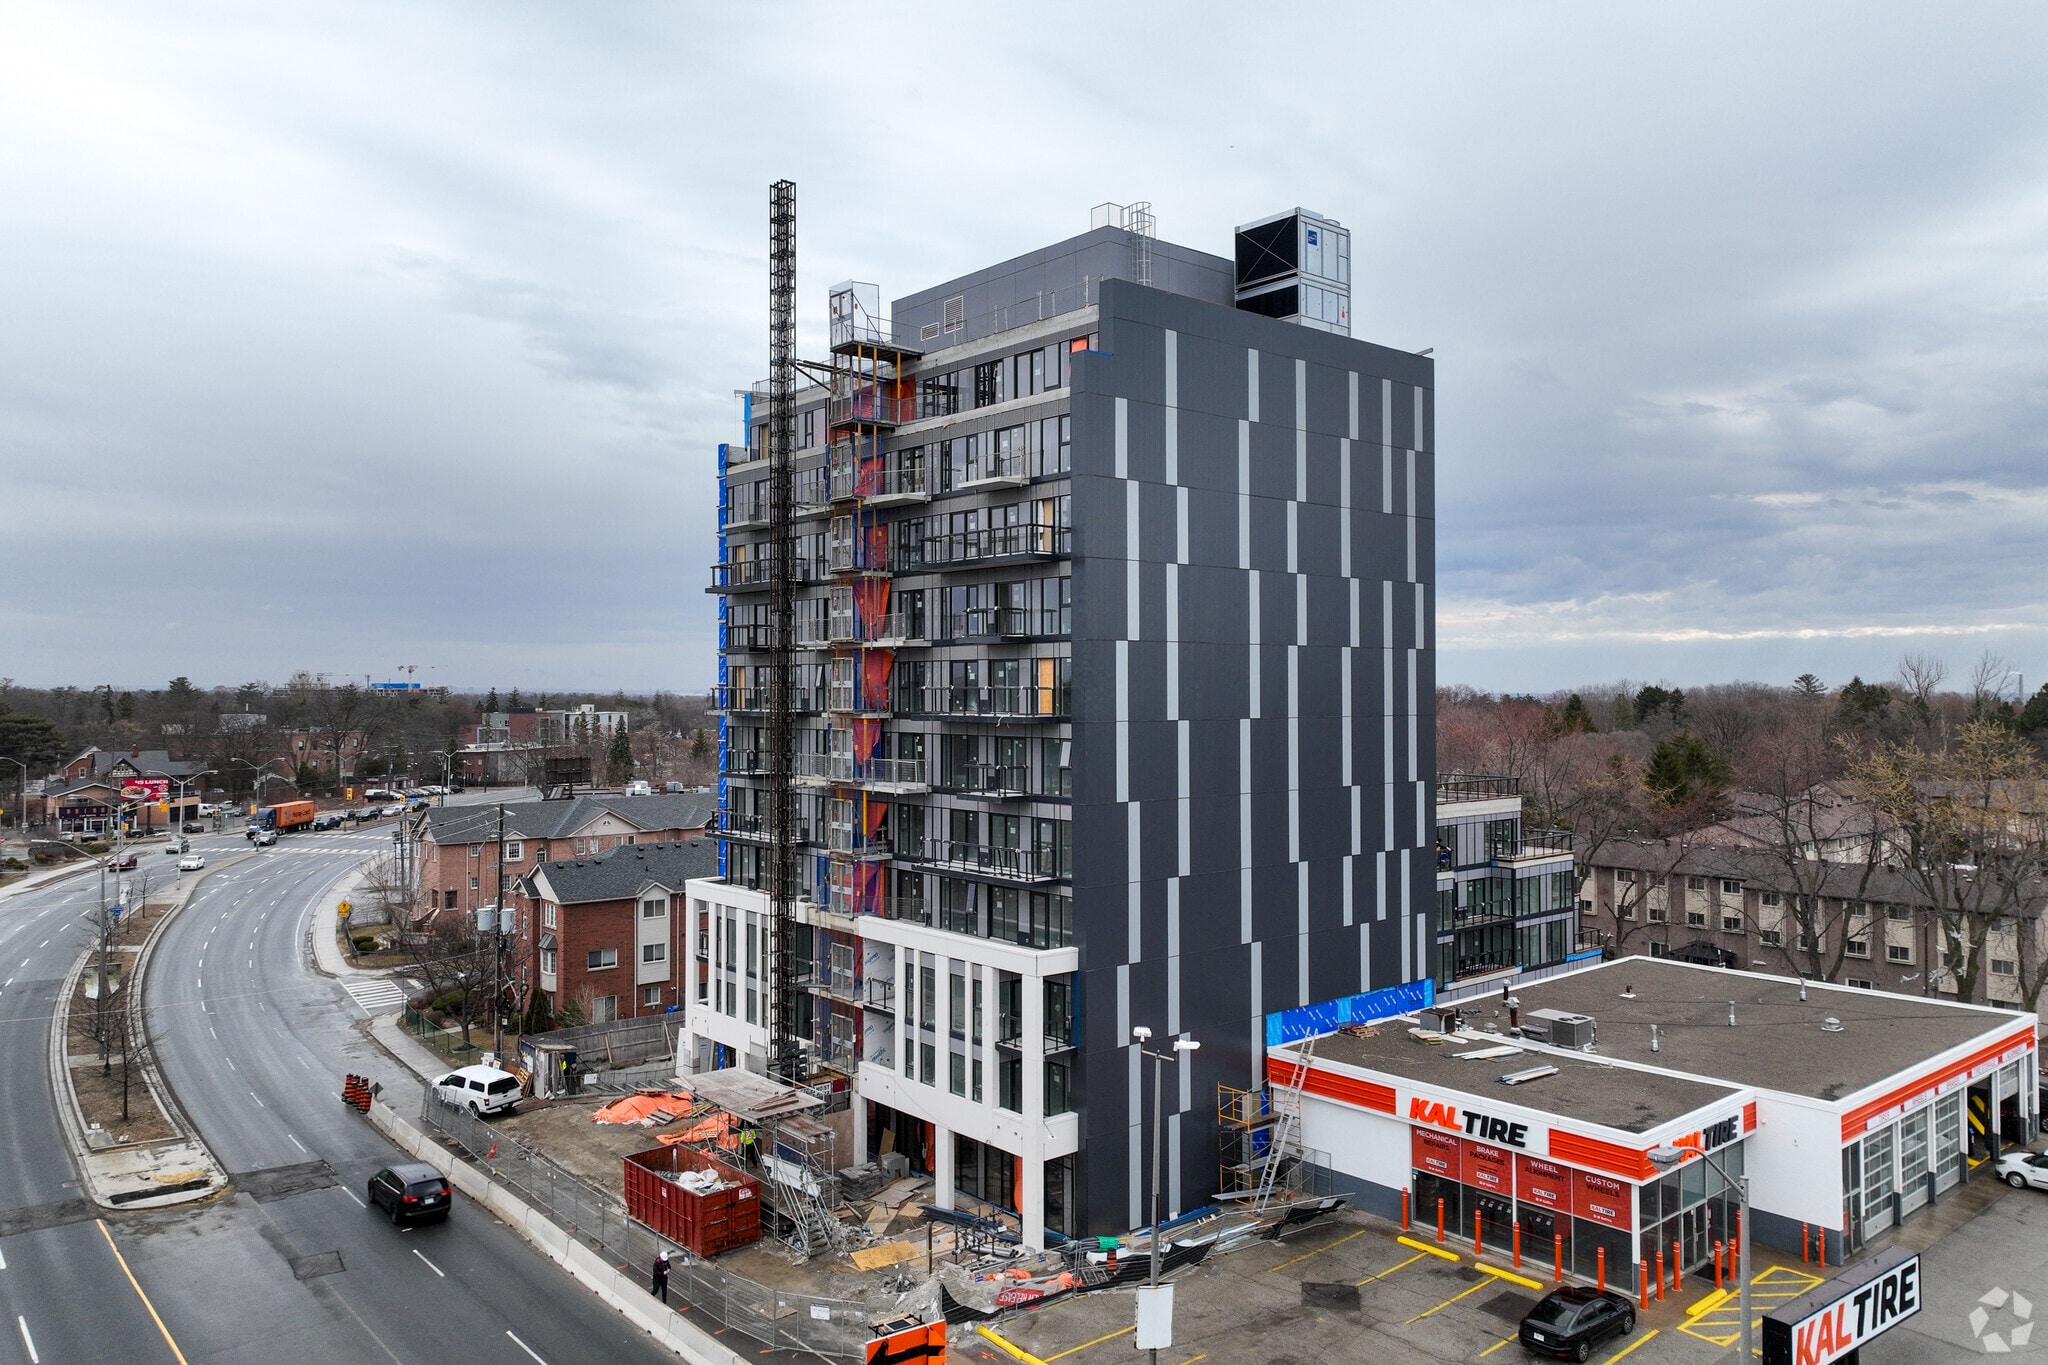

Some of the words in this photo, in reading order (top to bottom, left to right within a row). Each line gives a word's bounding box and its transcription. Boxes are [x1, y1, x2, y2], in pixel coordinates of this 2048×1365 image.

[1409, 1097, 1463, 1131] KAL
[1462, 1110, 1528, 1148] TIRE
[1416, 1129, 1457, 1145] MECHANICAL
[1703, 1115, 1739, 1151] TIRE
[1423, 1139, 1450, 1151] REPAIRS
[1476, 1145, 1499, 1157] BRAKE
[1469, 1151, 1505, 1166] PACKAGES
[1530, 1159, 1558, 1174] WHEEL
[1524, 1167, 1566, 1182] ALIGNMENT
[1585, 1175, 1620, 1191] CUSTOM
[1585, 1183, 1620, 1198] WHEELS
[1795, 1302, 1853, 1365] KAL
[1852, 1262, 1917, 1340] TIRE
